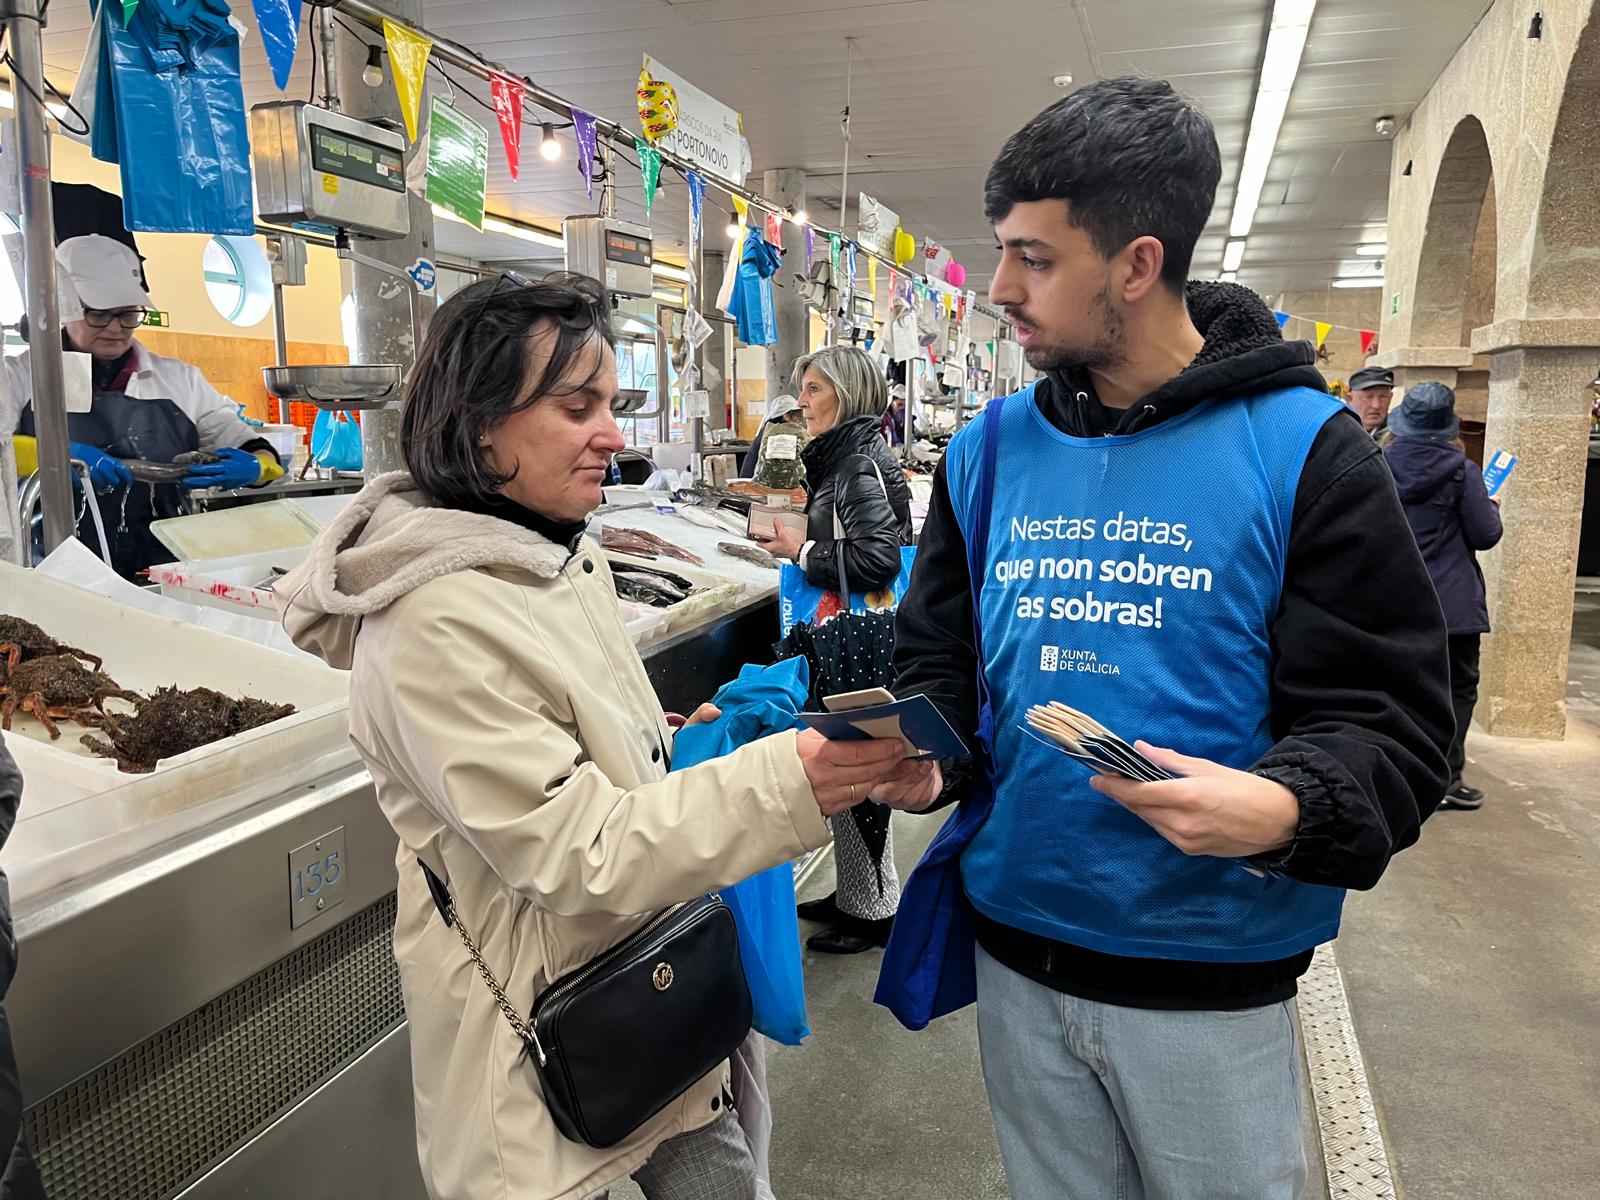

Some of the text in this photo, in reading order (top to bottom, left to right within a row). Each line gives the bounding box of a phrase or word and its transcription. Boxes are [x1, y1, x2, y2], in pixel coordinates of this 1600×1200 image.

[677, 129, 729, 170] PORTONOVO
[1010, 511, 1194, 553] Nestas datas,
[994, 553, 1214, 592] que non sobren
[1016, 591, 1164, 629] as sobras!
[1059, 660, 1121, 675] DE GALICIA
[1060, 649, 1098, 662] XUNTA
[296, 851, 340, 903] 135
